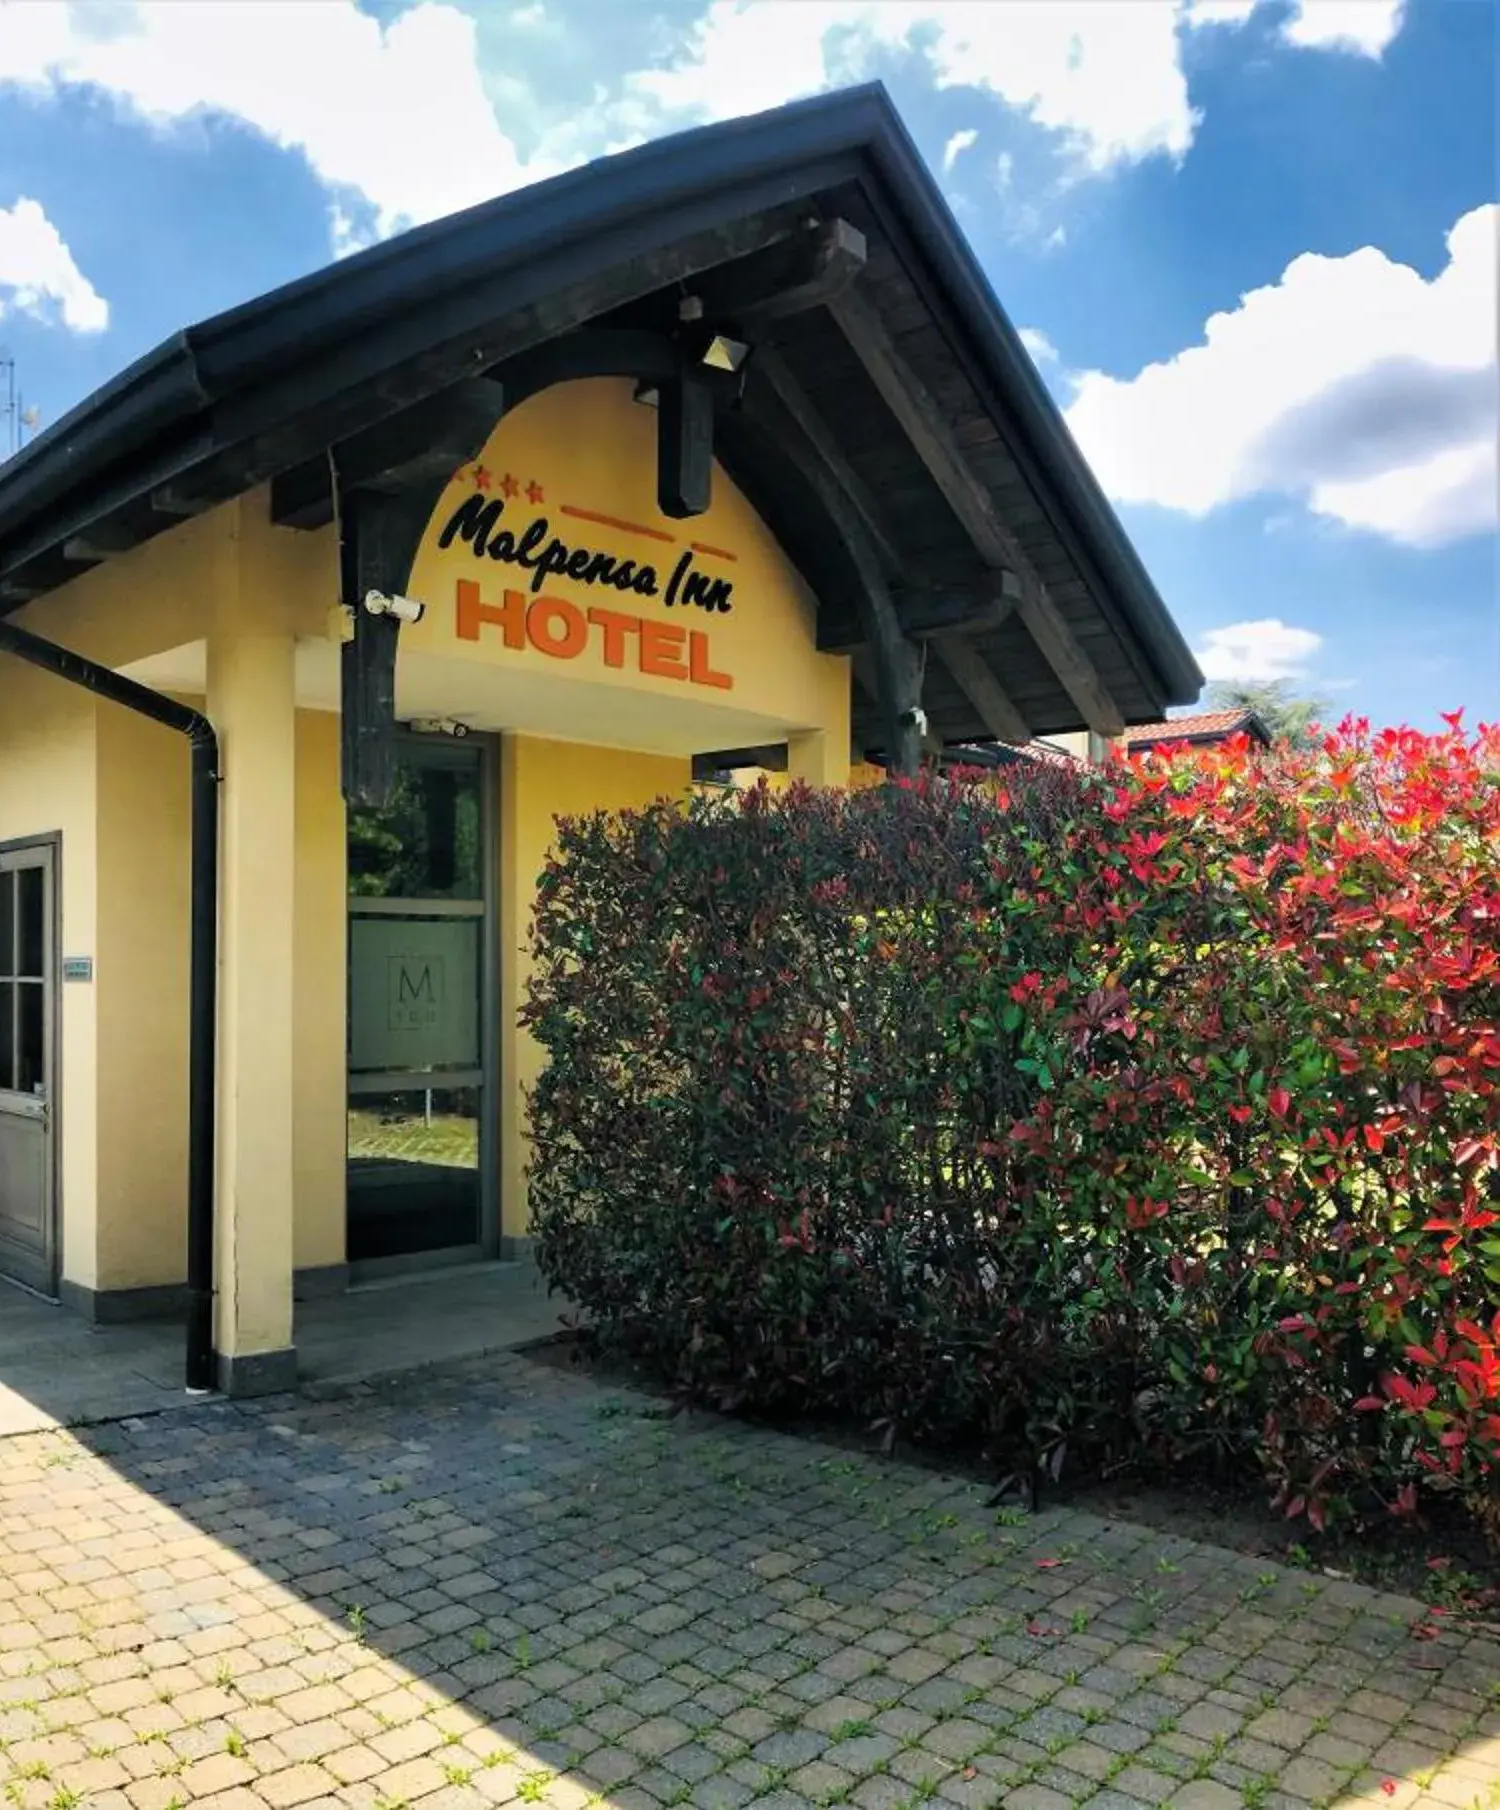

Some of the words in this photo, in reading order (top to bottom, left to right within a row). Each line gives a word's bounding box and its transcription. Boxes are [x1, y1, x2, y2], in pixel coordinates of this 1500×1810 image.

[438, 493, 658, 597] Malpensa
[664, 551, 733, 613] Inn
[455, 577, 735, 690] HOTEL
[398, 963, 437, 1003] M
